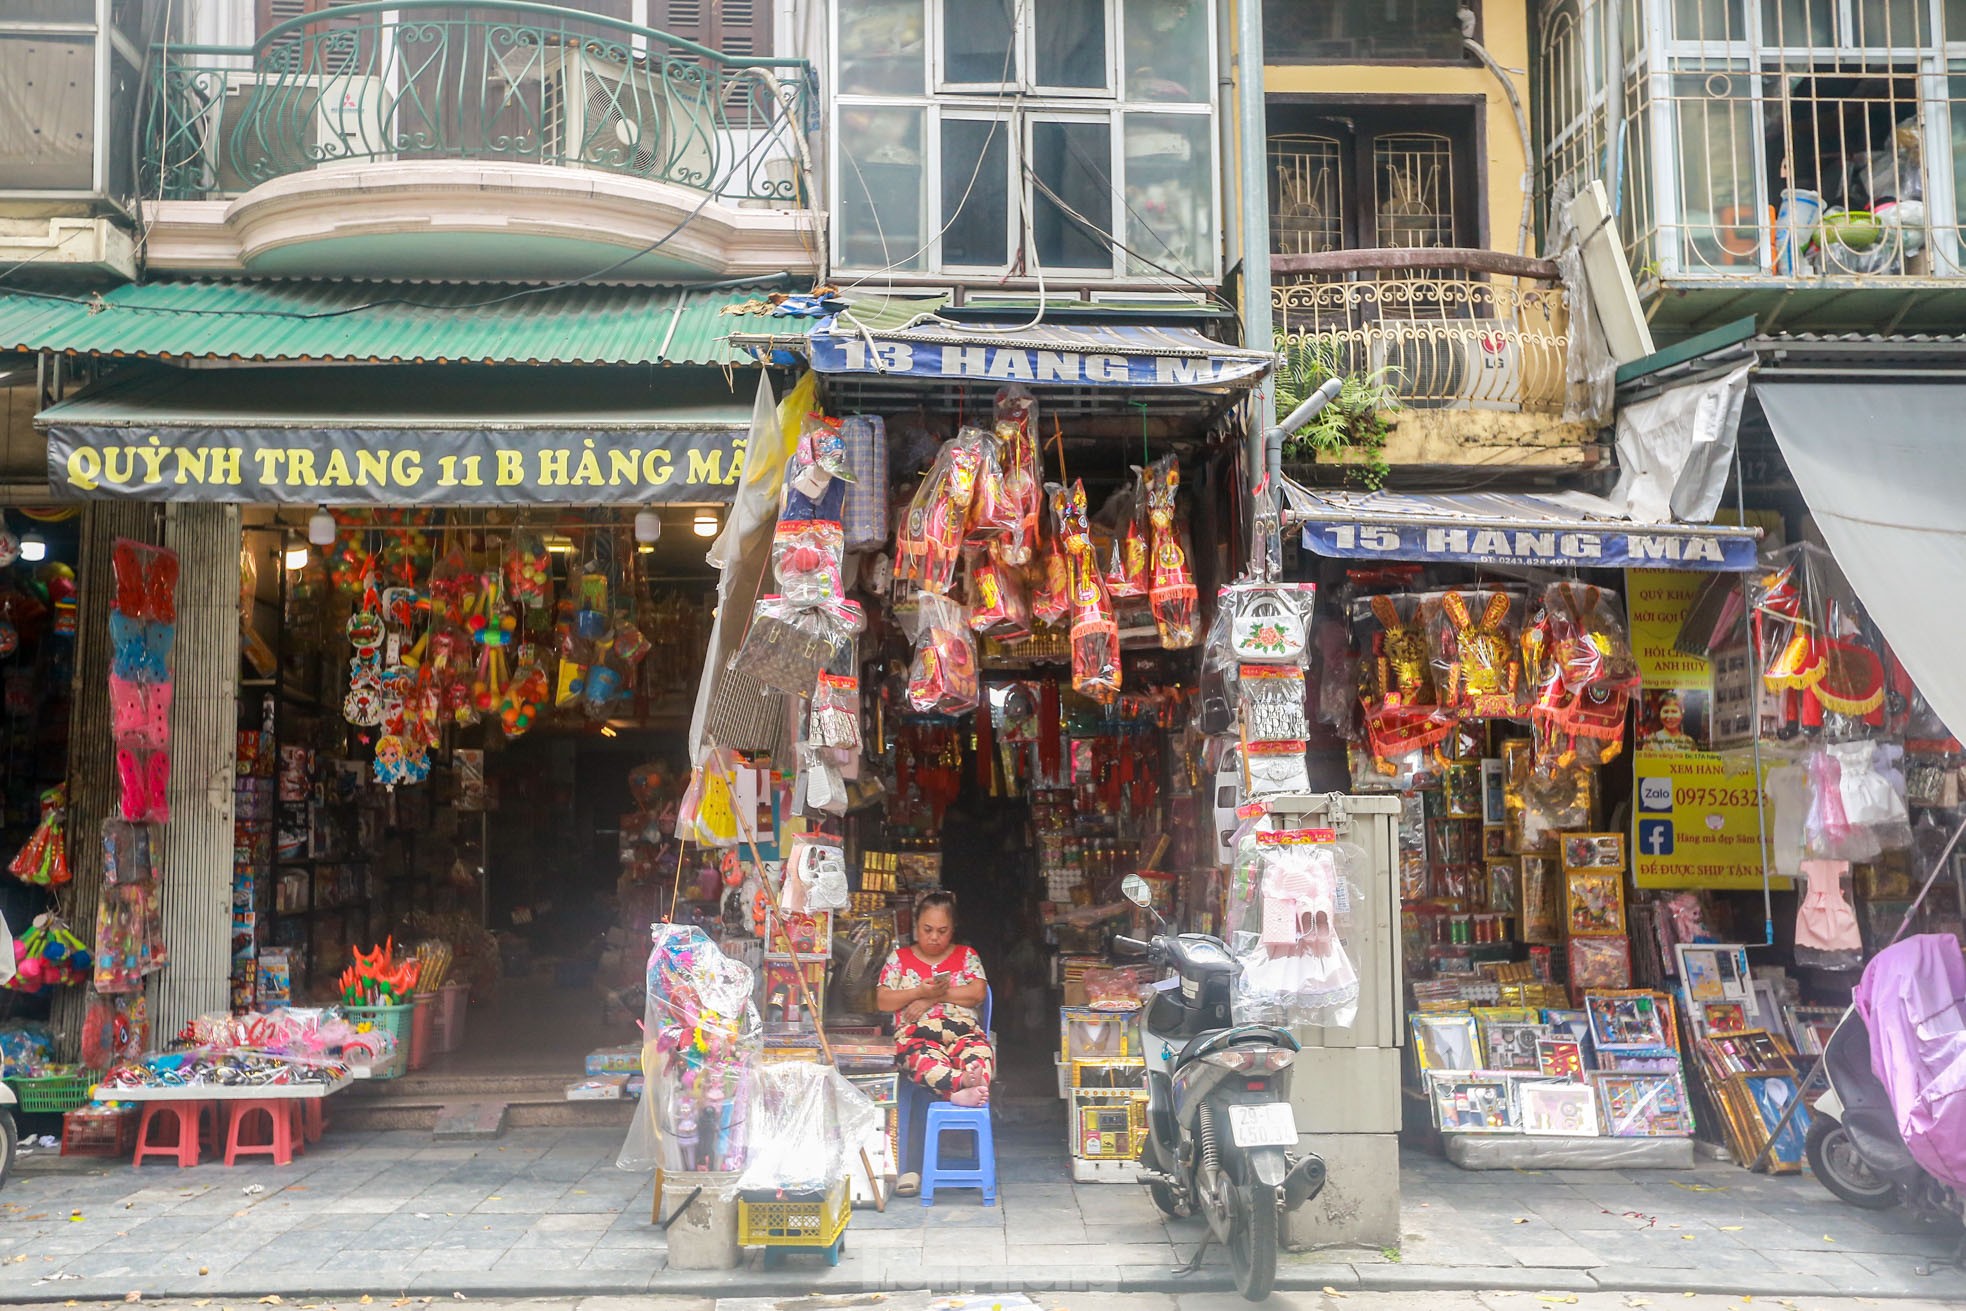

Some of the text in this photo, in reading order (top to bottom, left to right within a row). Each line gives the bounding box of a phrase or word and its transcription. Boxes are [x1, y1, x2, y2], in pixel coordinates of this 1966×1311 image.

[833, 340, 913, 372] 13
[940, 346, 1131, 382] HANG
[1485, 358, 1504, 369] LG
[67, 436, 242, 490] QUỲNH
[254, 448, 424, 487] TRANG
[437, 455, 483, 486] 11
[496, 449, 525, 486] B
[537, 439, 674, 486] HÀNG
[1324, 525, 1400, 551] 15
[1654, 661, 1679, 671] ANH
[1670, 764, 1693, 775] XEM
[1645, 788, 1670, 799] Zalo
[1698, 865, 1725, 875] SHIP
